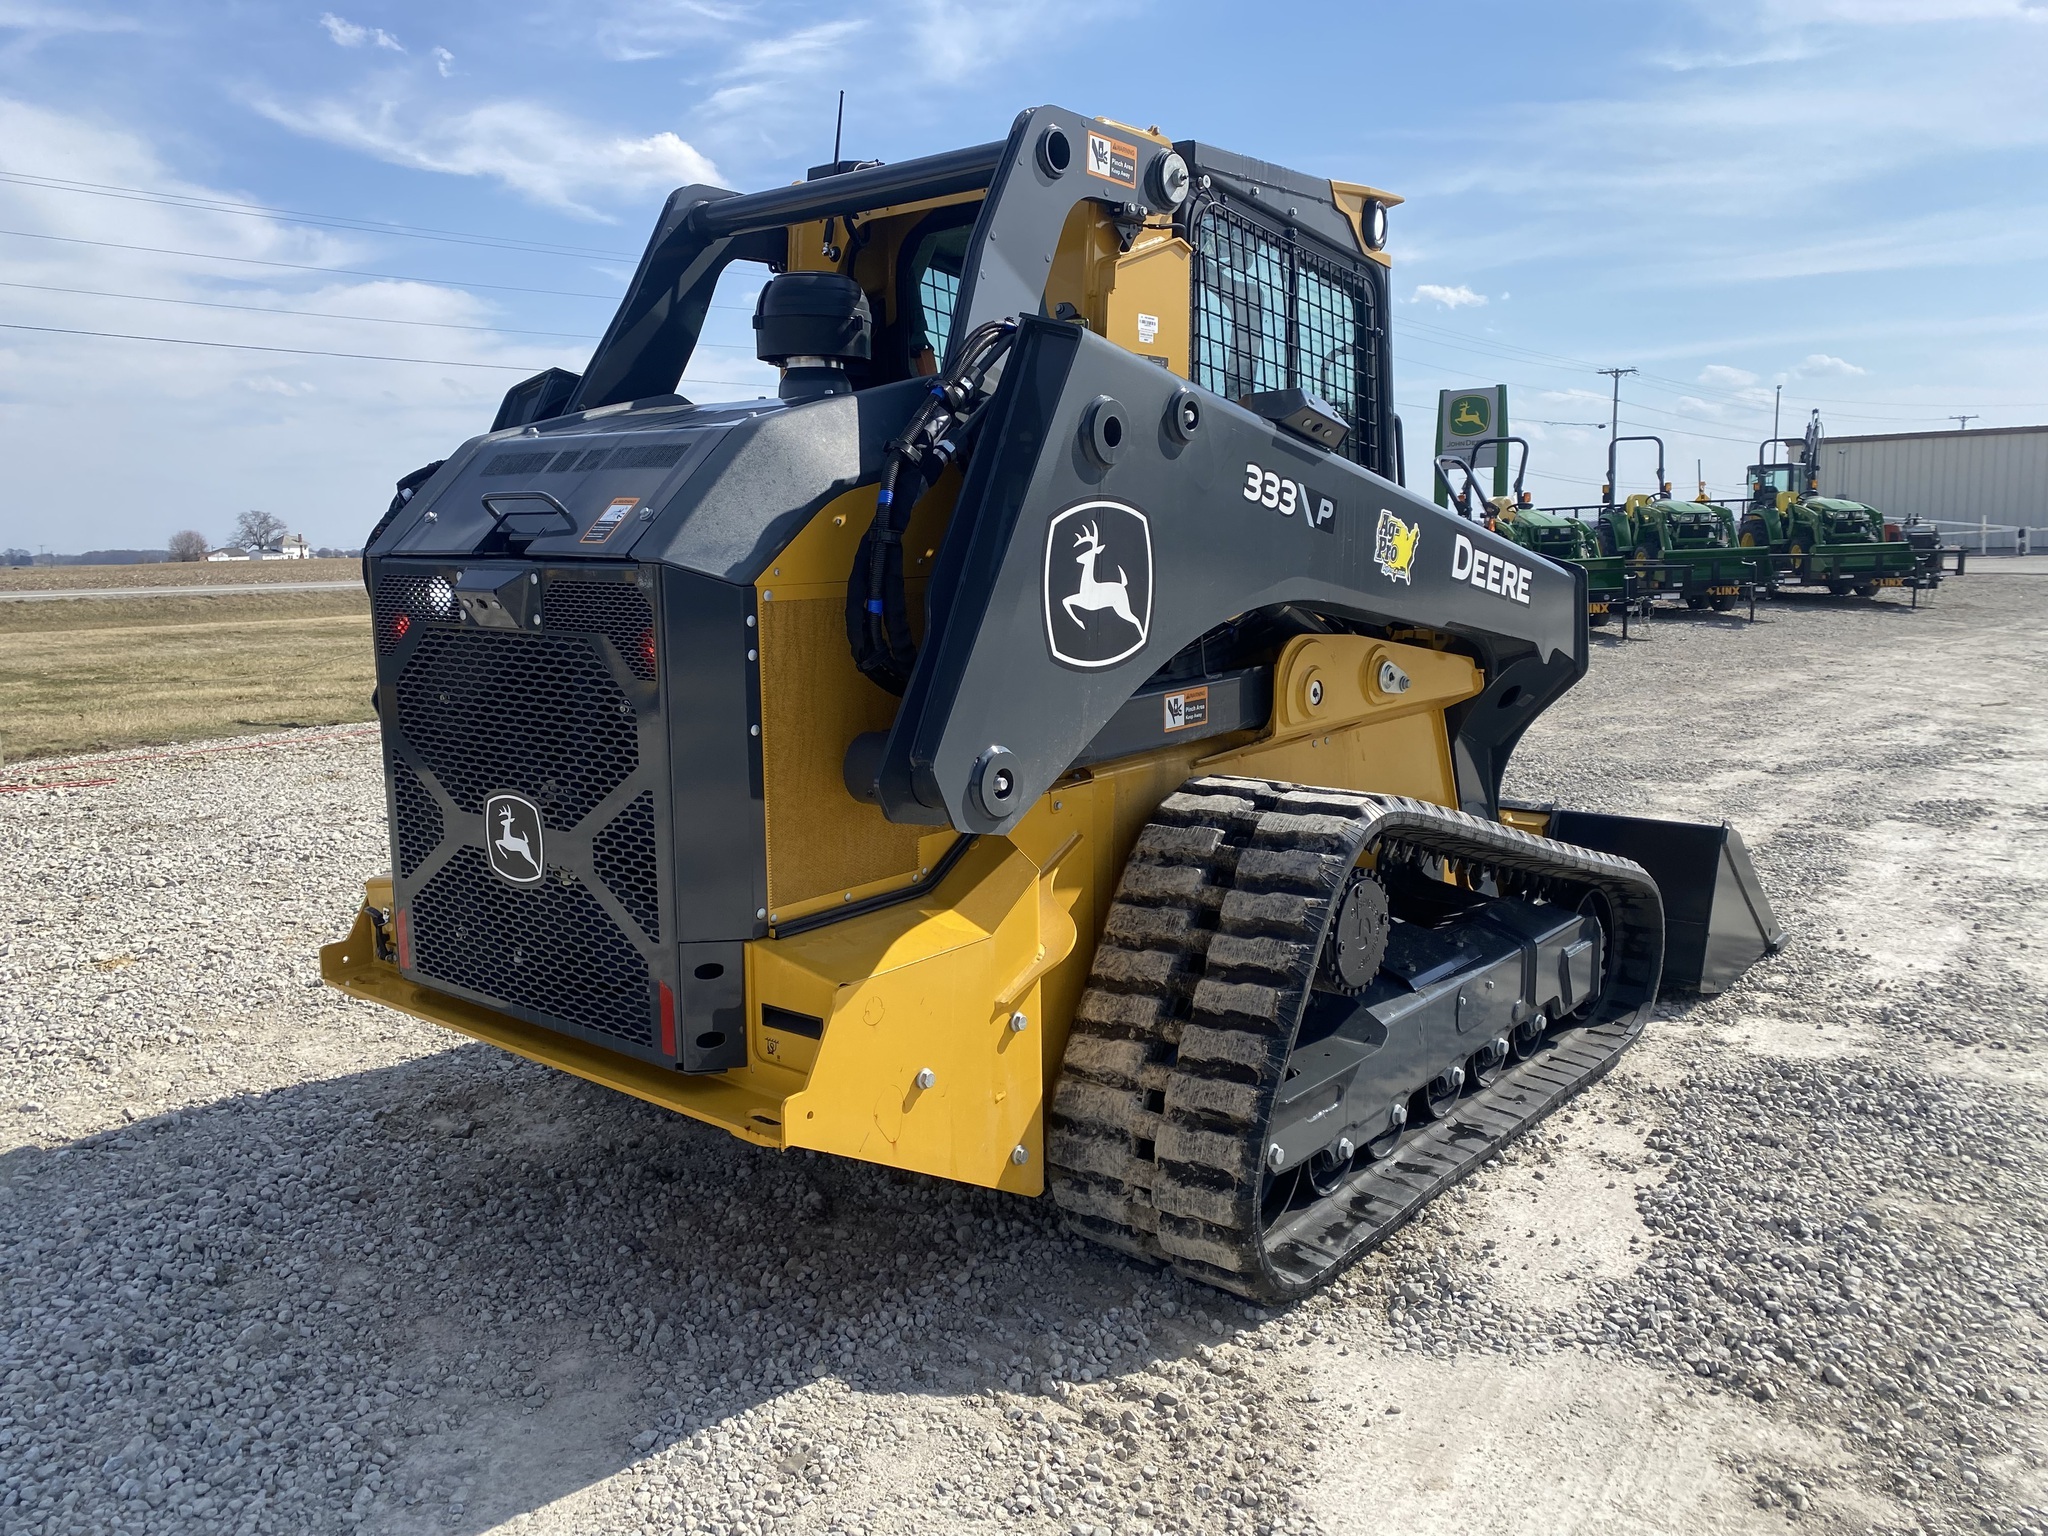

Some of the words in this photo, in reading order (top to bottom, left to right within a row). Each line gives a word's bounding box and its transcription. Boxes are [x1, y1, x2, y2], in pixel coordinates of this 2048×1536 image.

[1116, 144, 1135, 156] WARNING
[1111, 157, 1124, 168] Pinch
[1123, 162, 1134, 171] Area
[1111, 167, 1121, 175] Keep
[1120, 170, 1131, 179] Away
[1376, 537, 1398, 562] Pro
[1452, 533, 1533, 604] DEERE
[1880, 578, 1903, 587] LINX
[1716, 586, 1740, 596] LINX
[1588, 602, 1610, 614] INX
[1185, 705, 1196, 713] Pinch
